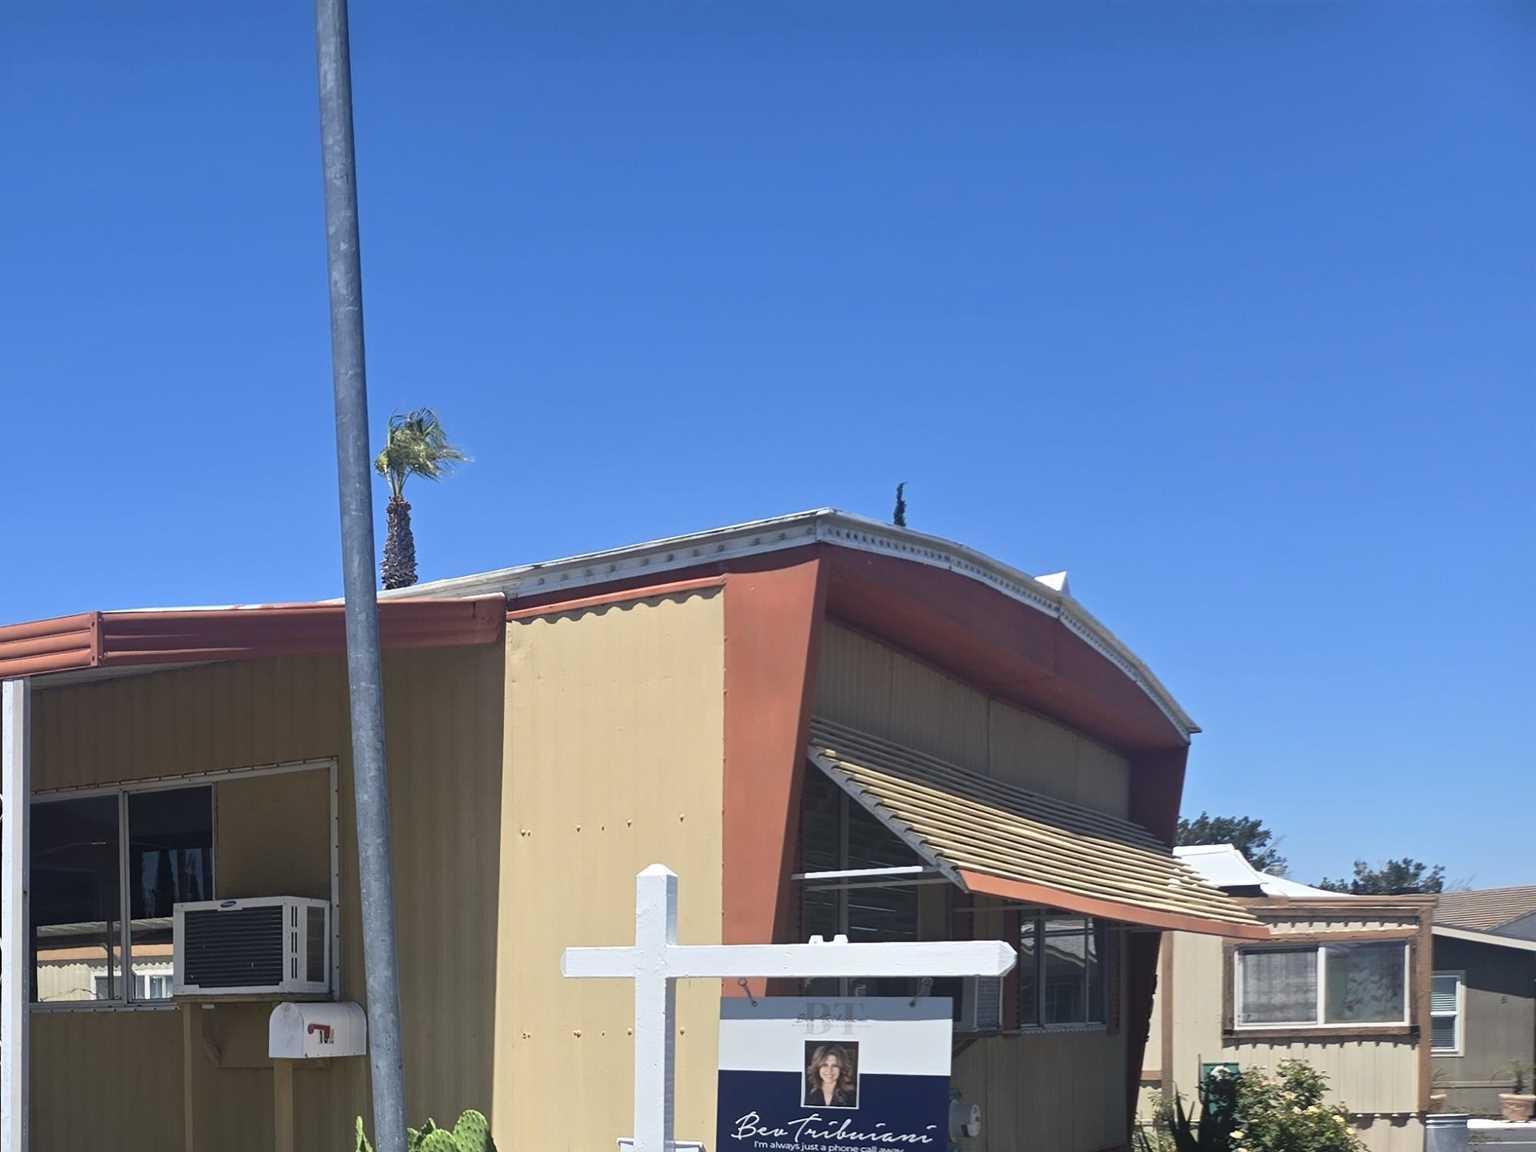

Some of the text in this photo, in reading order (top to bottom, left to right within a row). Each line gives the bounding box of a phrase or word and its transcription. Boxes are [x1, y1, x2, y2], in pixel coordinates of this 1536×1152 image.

[730, 1111, 937, 1143] Bev Tribuiani
[769, 1141, 800, 1151] always
[801, 1142, 819, 1151] just
